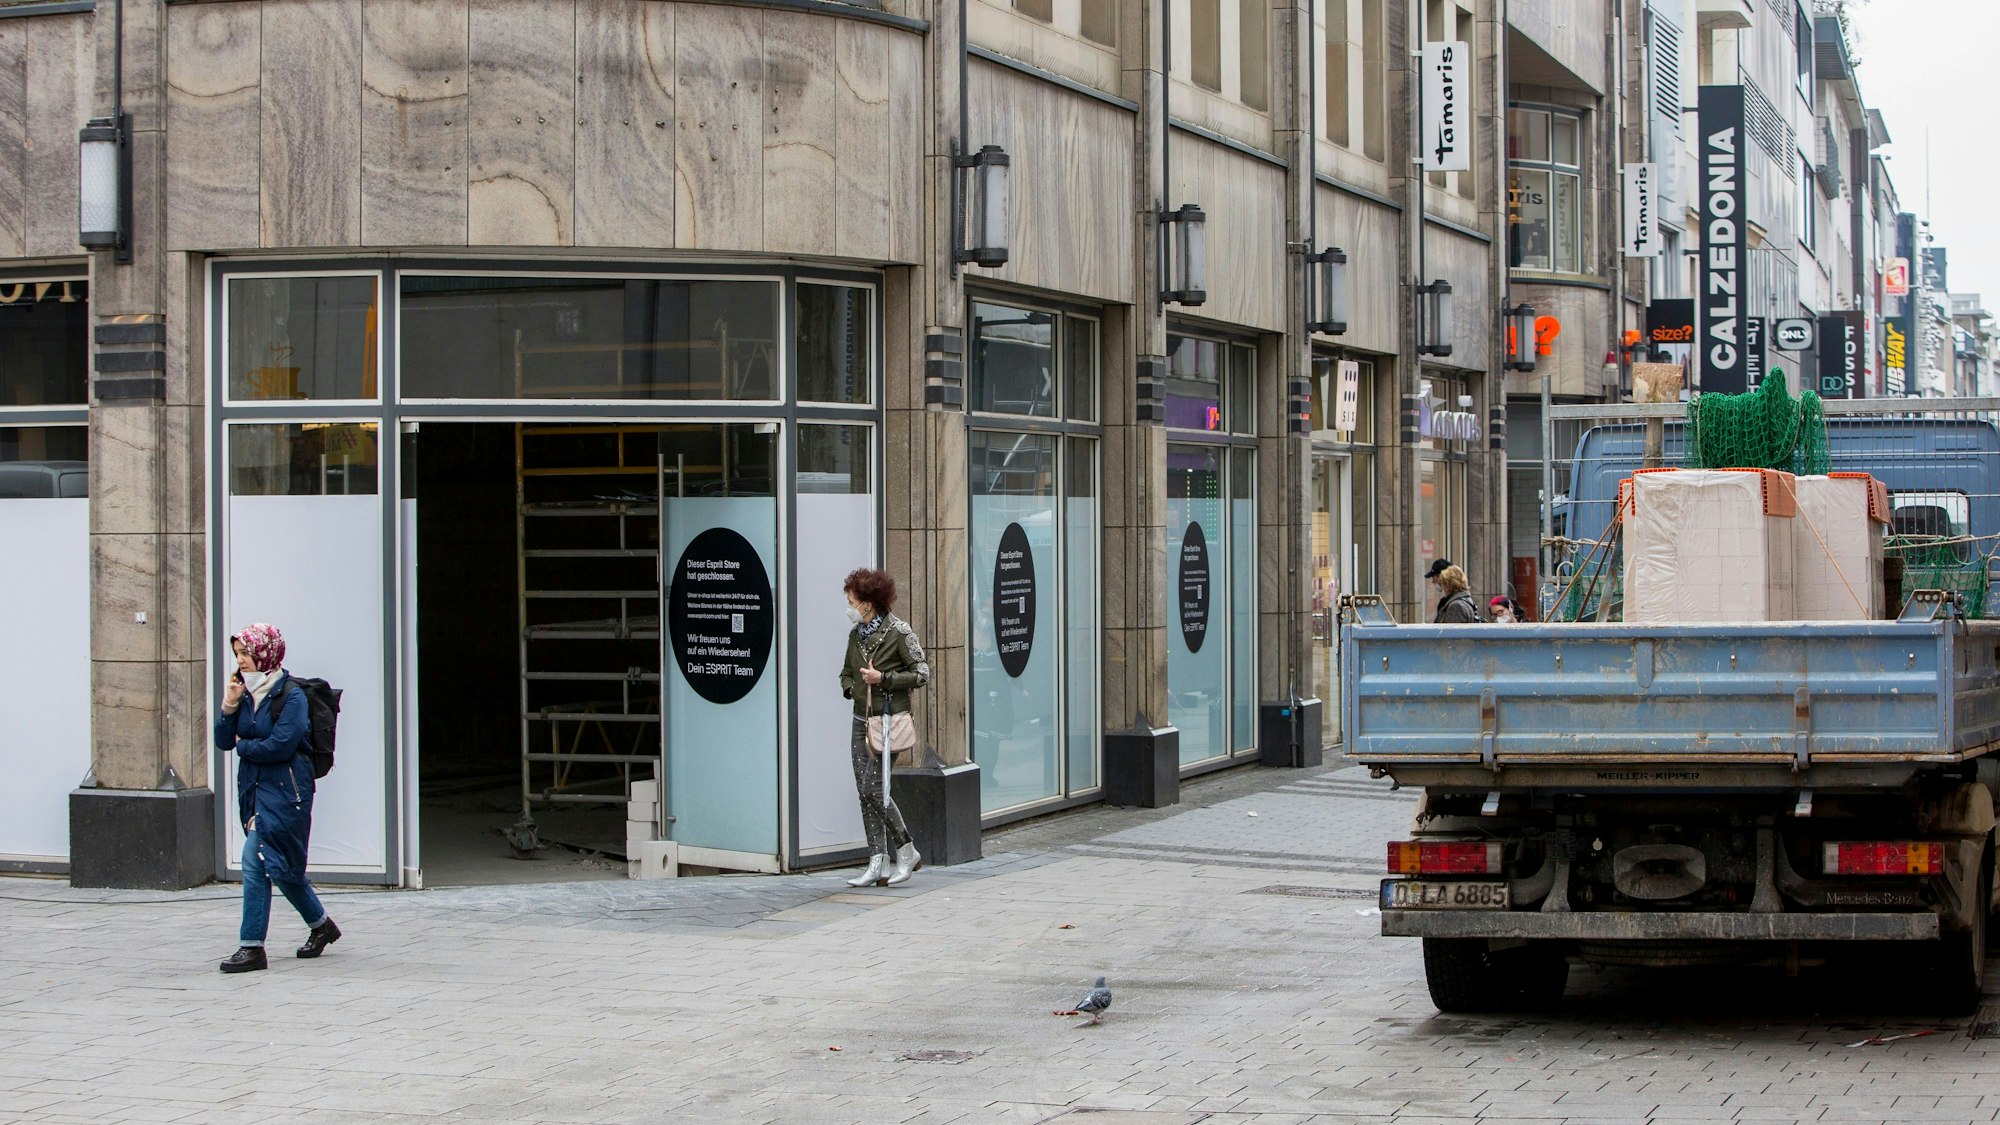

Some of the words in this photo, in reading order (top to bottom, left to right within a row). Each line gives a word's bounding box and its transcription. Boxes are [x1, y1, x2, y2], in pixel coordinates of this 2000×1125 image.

[1435, 46, 1454, 166] tamaris
[1634, 167, 1648, 253] tamaris
[1708, 126, 1737, 370] CALZEDONIA
[1652, 324, 1693, 341] size?
[1780, 330, 1810, 340] ONLY
[1844, 326, 1857, 399] FOSSI
[1887, 322, 1906, 398] SUBWAY
[1343, 411, 1355, 422] SIX
[687, 559, 706, 569] Dieser
[706, 559, 723, 570] Esprit
[724, 560, 740, 569] Store
[687, 571, 697, 580] hat
[697, 571, 735, 581] geschlossen.
[687, 633, 699, 643] Wir
[699, 634, 719, 644] freuen
[720, 637, 731, 645] uns
[687, 645, 697, 655] auf
[697, 646, 707, 656] ein
[707, 646, 751, 658] Wiedersehen!
[687, 662, 704, 674] Dein
[706, 663, 732, 675] ESPRIT
[733, 664, 754, 676] Team
[1597, 772, 1700, 780] MEILLER-KIPPER
[1454, 884, 1505, 905] 6885
[1826, 892, 1912, 905] Mercedes-Benz
